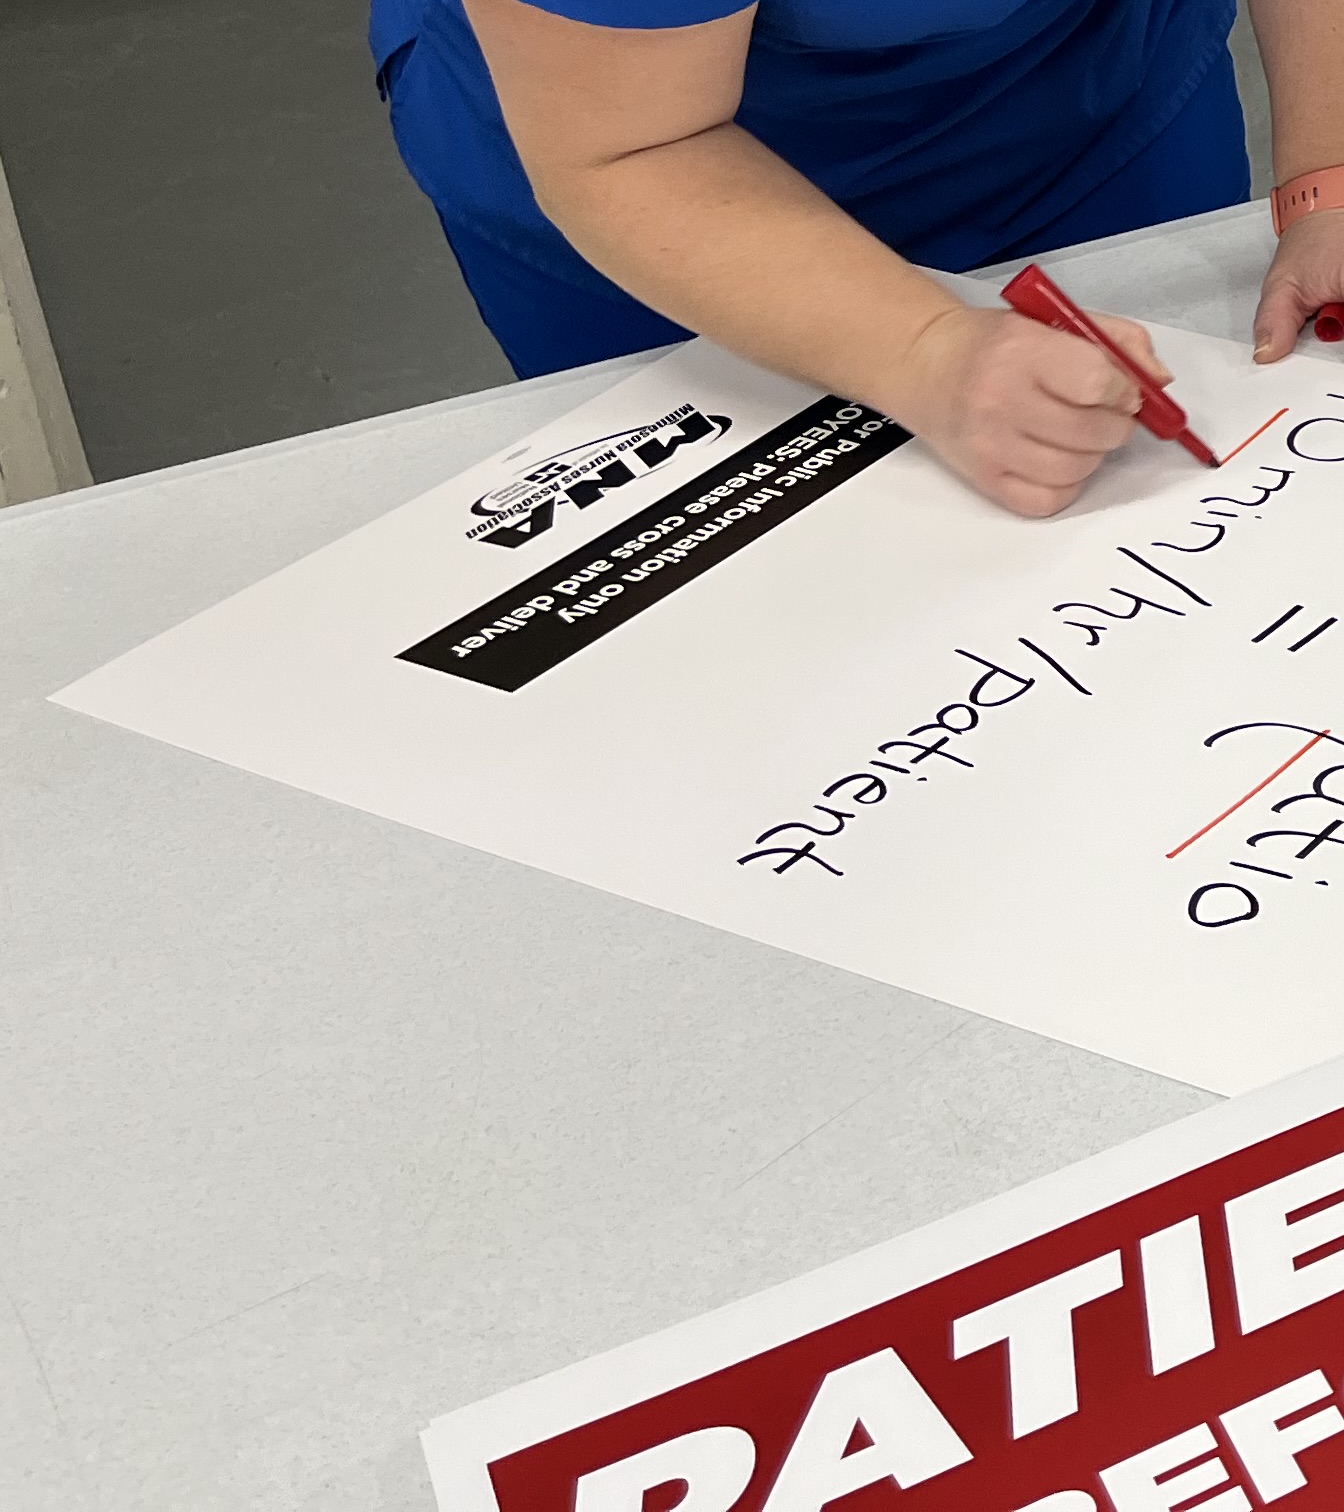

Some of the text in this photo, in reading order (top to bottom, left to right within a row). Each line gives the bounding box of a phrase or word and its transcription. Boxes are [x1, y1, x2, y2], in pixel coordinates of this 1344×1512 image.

[616, 402, 696, 452] Minnesota
[477, 411, 717, 549] MNA
[562, 449, 618, 485] Nurses
[775, 439, 861, 496] Public
[451, 402, 863, 659] OYEES: Please cross and deliver
[465, 481, 561, 540] Association
[622, 488, 780, 583] Information
[557, 583, 625, 625] only
